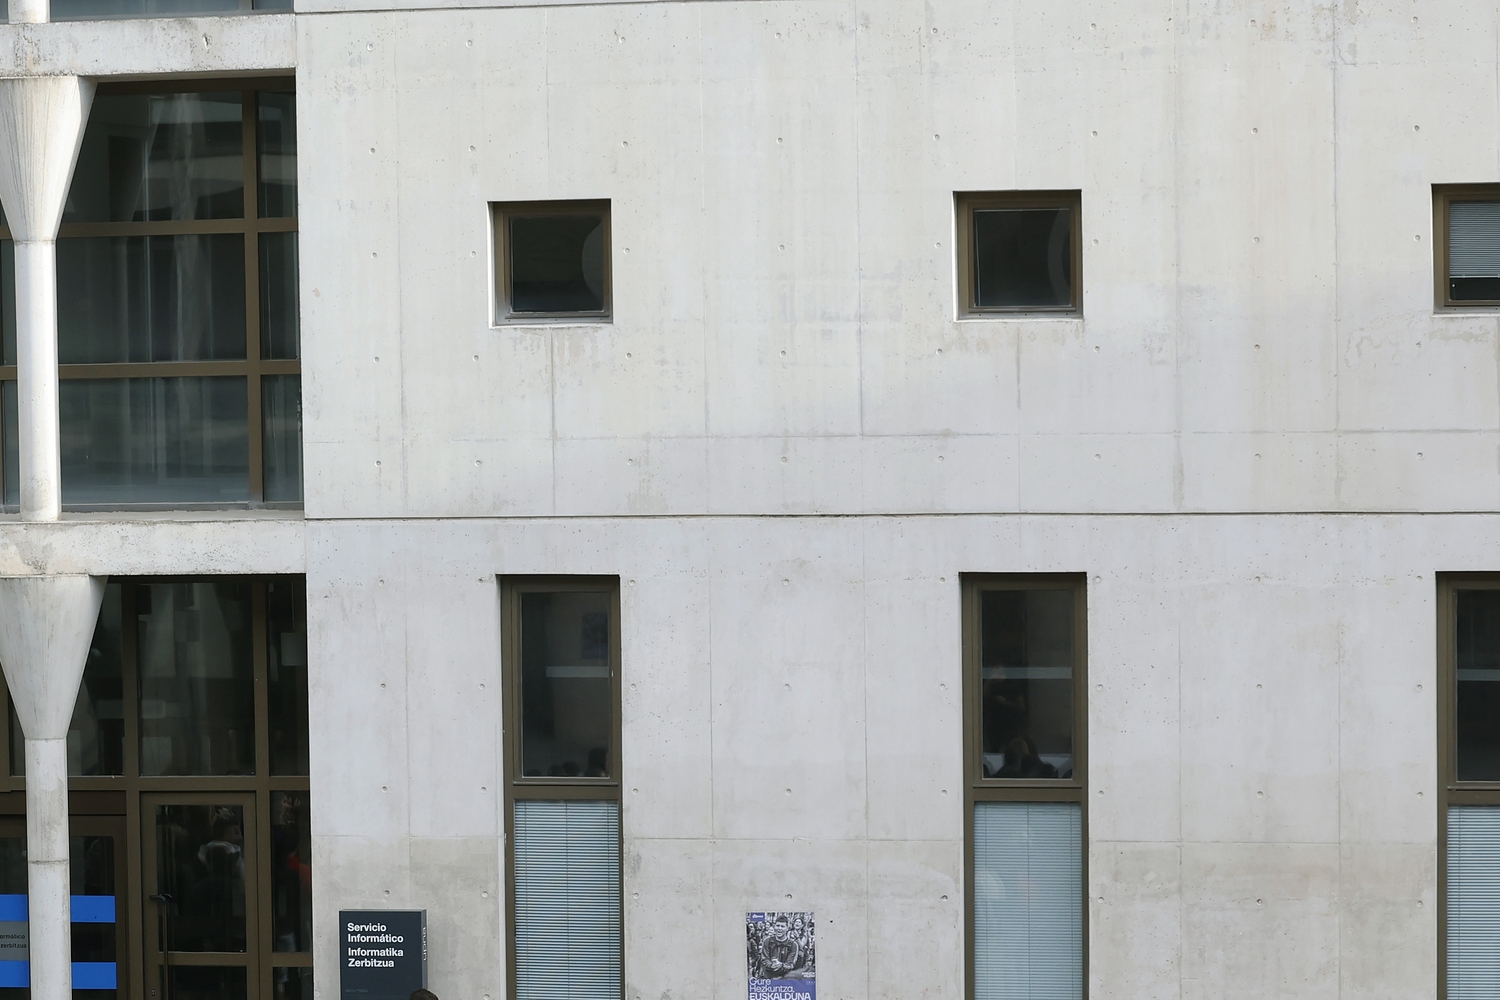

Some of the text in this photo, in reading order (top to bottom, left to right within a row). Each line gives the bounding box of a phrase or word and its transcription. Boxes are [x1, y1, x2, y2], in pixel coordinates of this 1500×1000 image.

[347, 922, 386, 932] Servicio
[348, 933, 404, 943] Informático
[348, 947, 404, 957] Informatika
[348, 958, 395, 968] Zerbitzua
[749, 977, 772, 985] Gure
[749, 985, 795, 993] Hezkuntza,
[749, 992, 811, 1000] EUSKALDUNA
